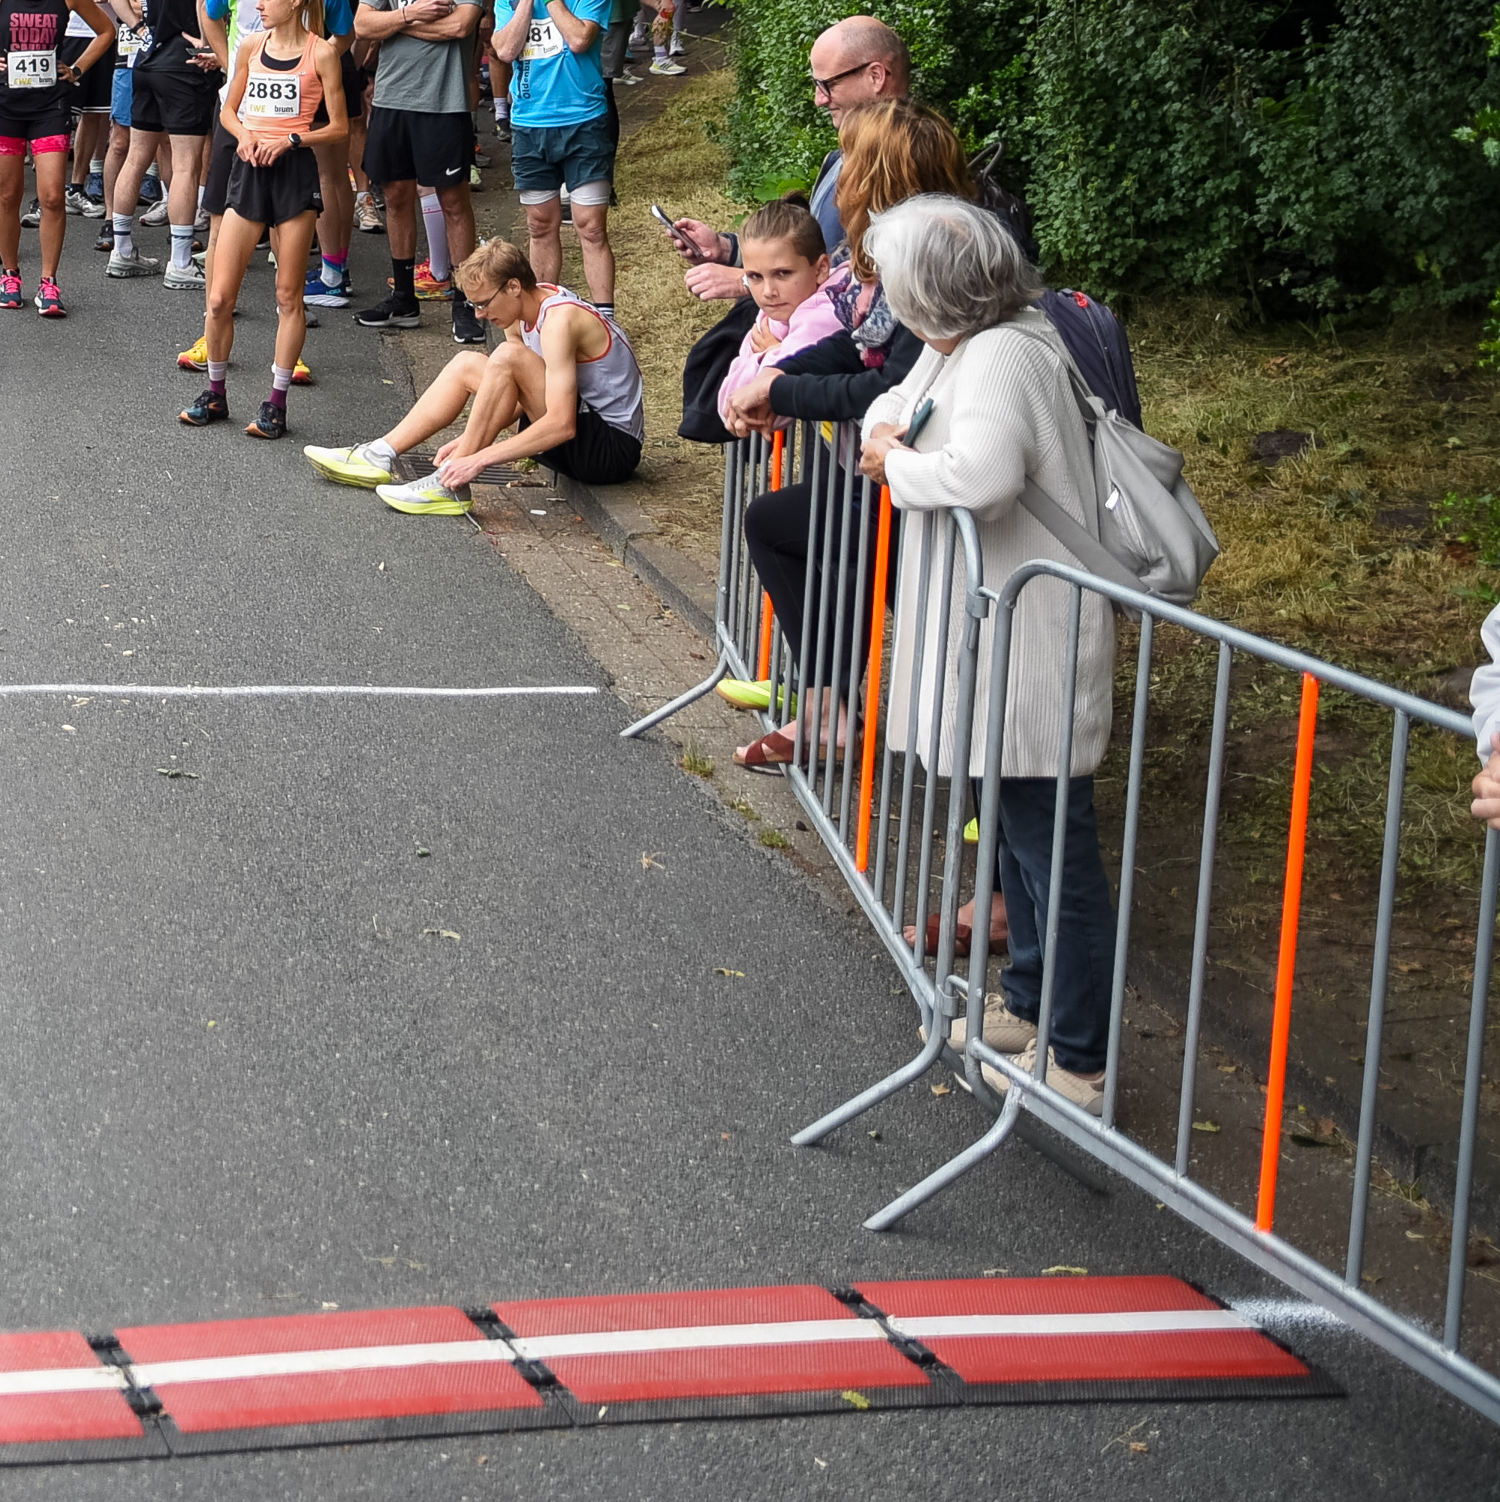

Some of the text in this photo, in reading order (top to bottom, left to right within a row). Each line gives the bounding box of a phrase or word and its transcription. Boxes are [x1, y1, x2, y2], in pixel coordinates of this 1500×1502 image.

[9, 12, 59, 28] SWEAT
[9, 27, 58, 44] TODAY
[15, 57, 50, 73] 419
[248, 81, 298, 100] 2883
[274, 104, 294, 113] bruns
